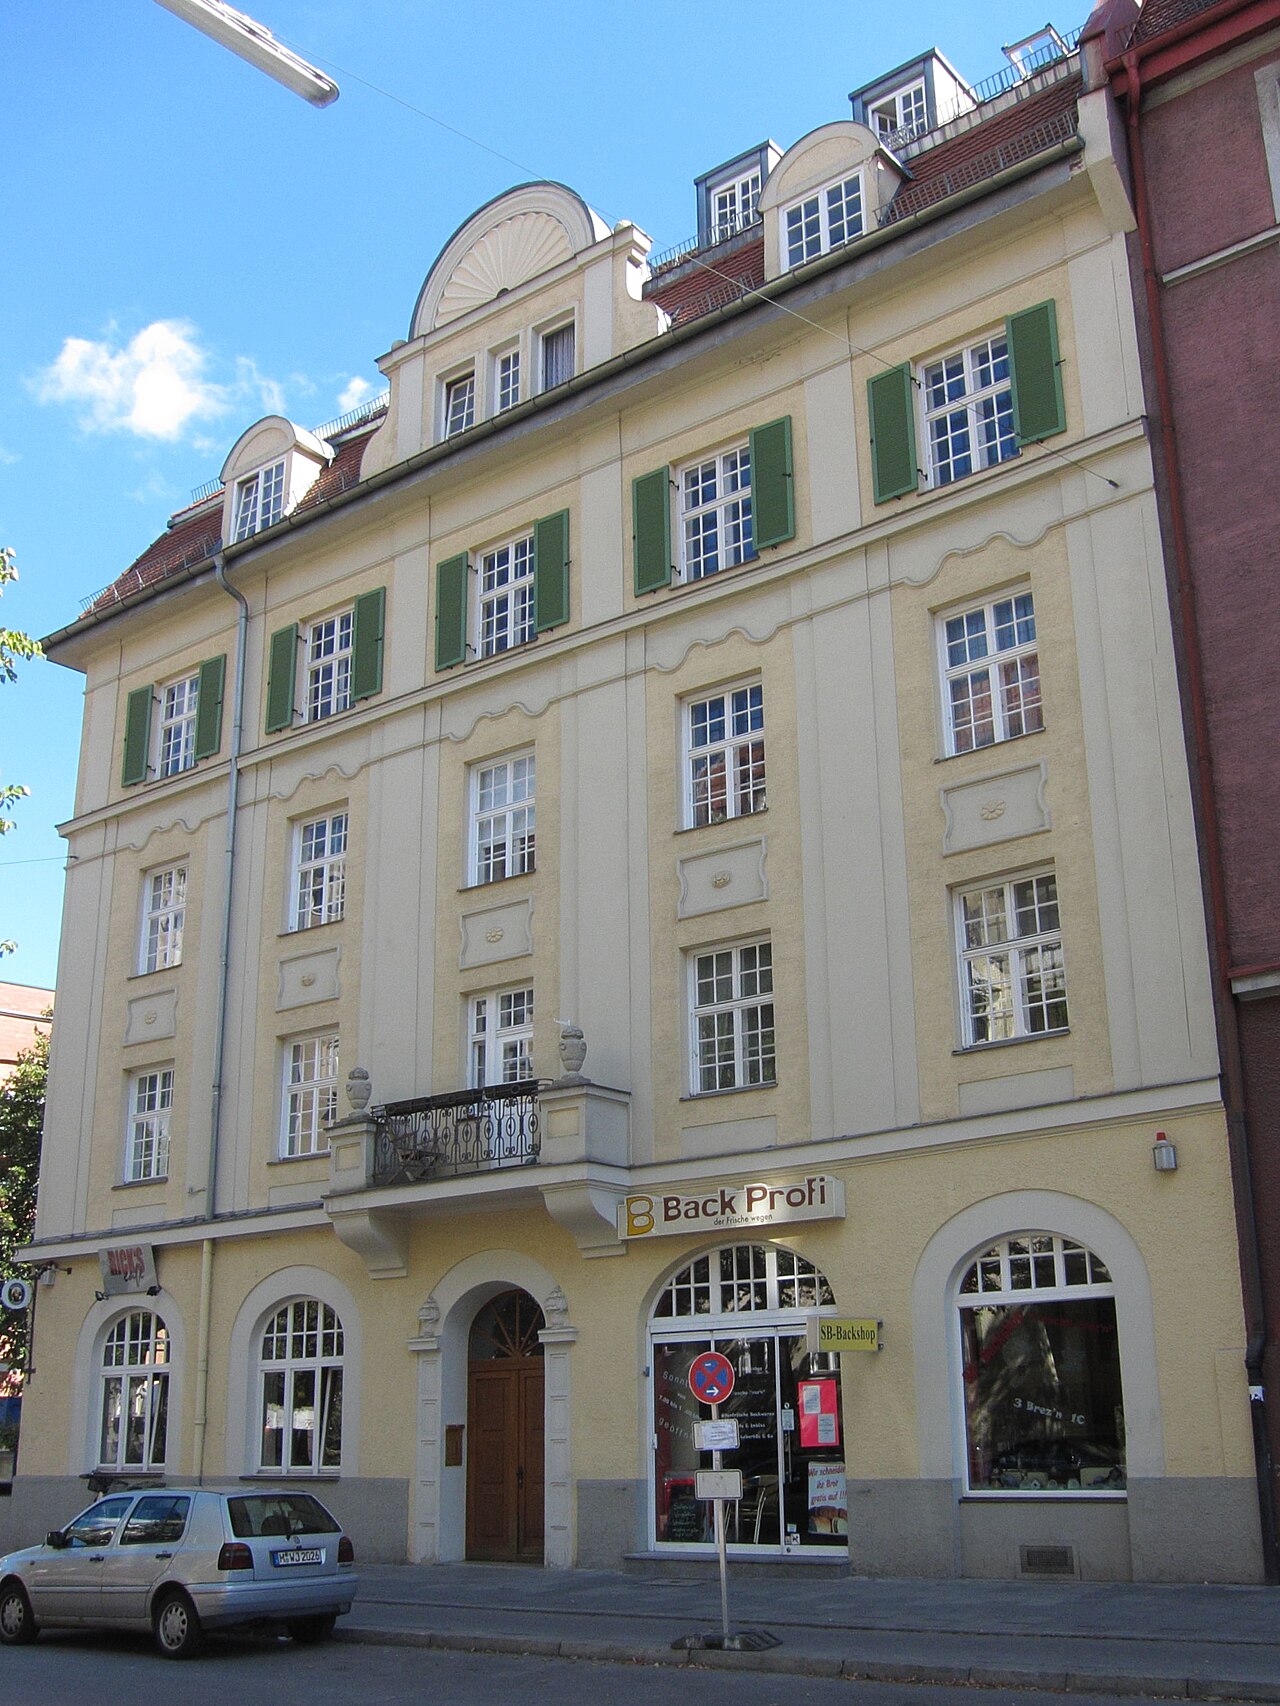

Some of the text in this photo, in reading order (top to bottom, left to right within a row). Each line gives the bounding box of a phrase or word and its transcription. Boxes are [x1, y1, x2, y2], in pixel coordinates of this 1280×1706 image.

[663, 1176, 827, 1222] Back Profi
[713, 1213, 773, 1226] der Frische wegen
[820, 1325, 876, 1344] SB-Backshop
[662, 1370, 689, 1388] Sonnt
[1013, 1398, 1023, 1408] 3
[1026, 1401, 1063, 1419] Brez'n
[279, 1552, 286, 1563] M
